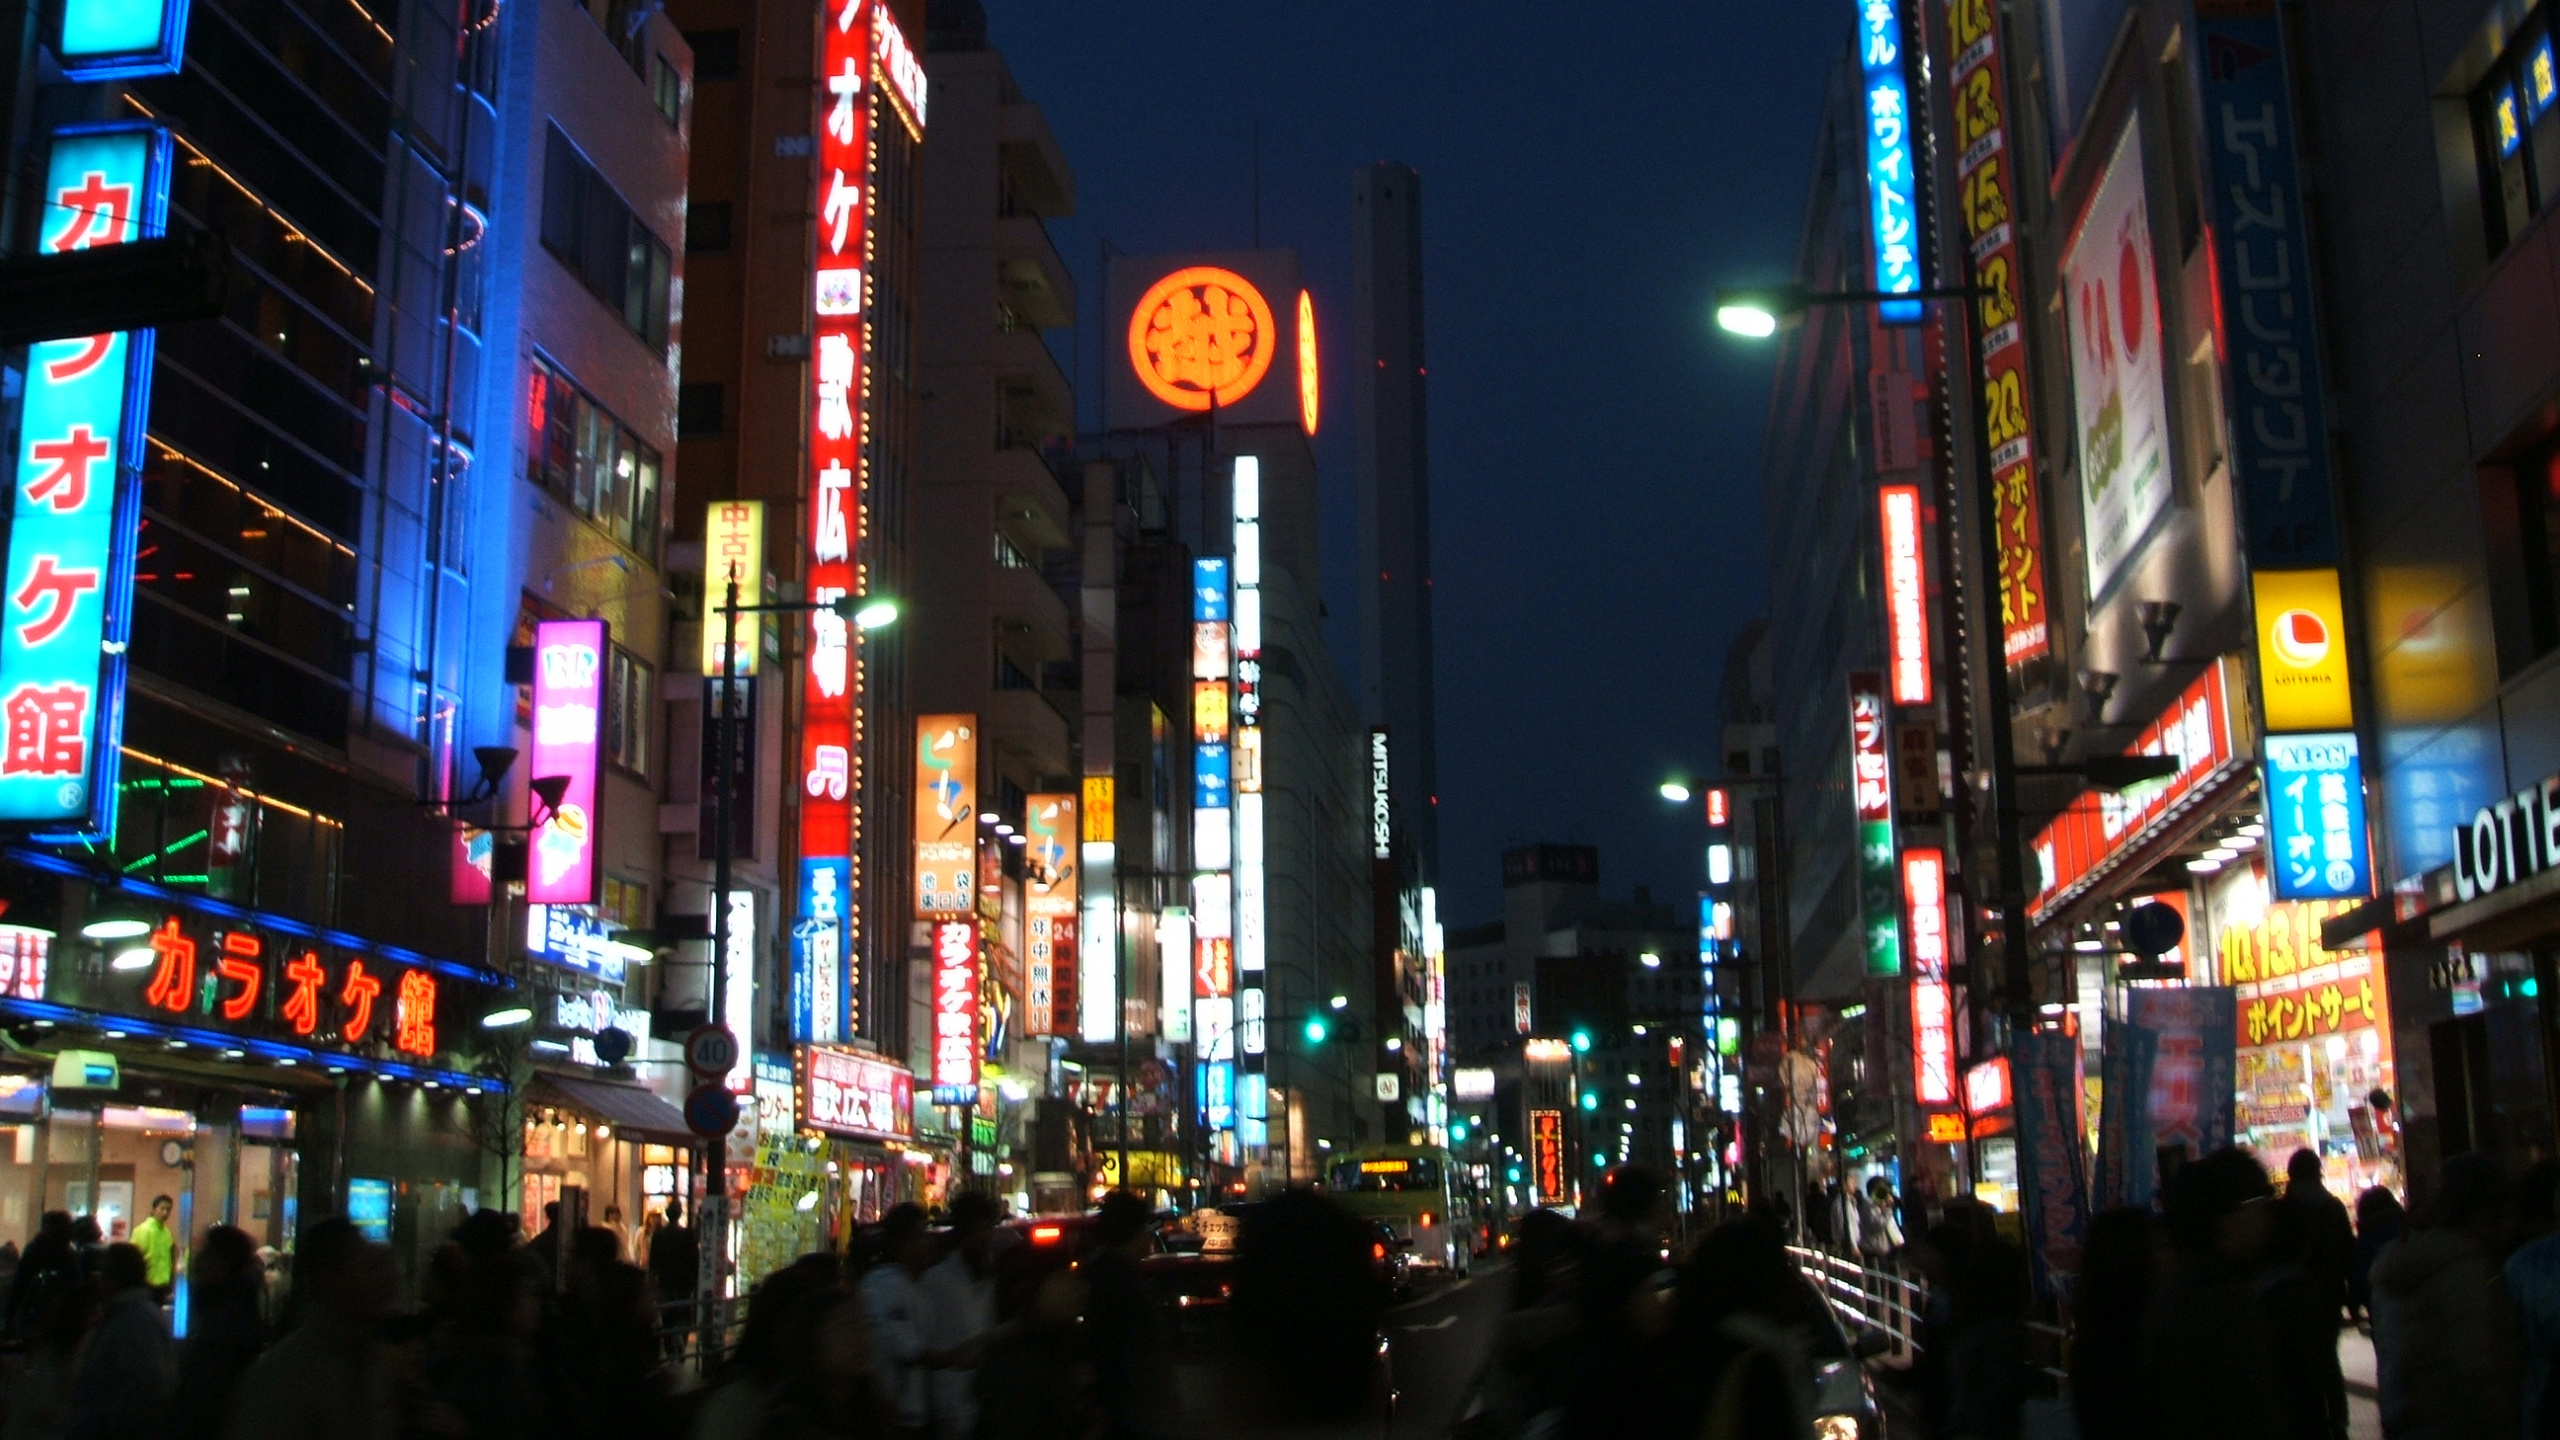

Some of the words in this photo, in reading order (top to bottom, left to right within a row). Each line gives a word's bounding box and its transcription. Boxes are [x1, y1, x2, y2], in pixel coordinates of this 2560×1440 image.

[2273, 671, 2332, 687] LOTTERIA
[2279, 744, 2348, 769] AEON
[1372, 732, 1390, 859] MITSUKOSHI
[2284, 773, 2317, 889] イーオン
[147, 915, 437, 1058] カラオケ館
[697, 1039, 727, 1064] 40
[811, 1078, 895, 1132] 歌広場
[1202, 1220, 1235, 1232] チェッカー
